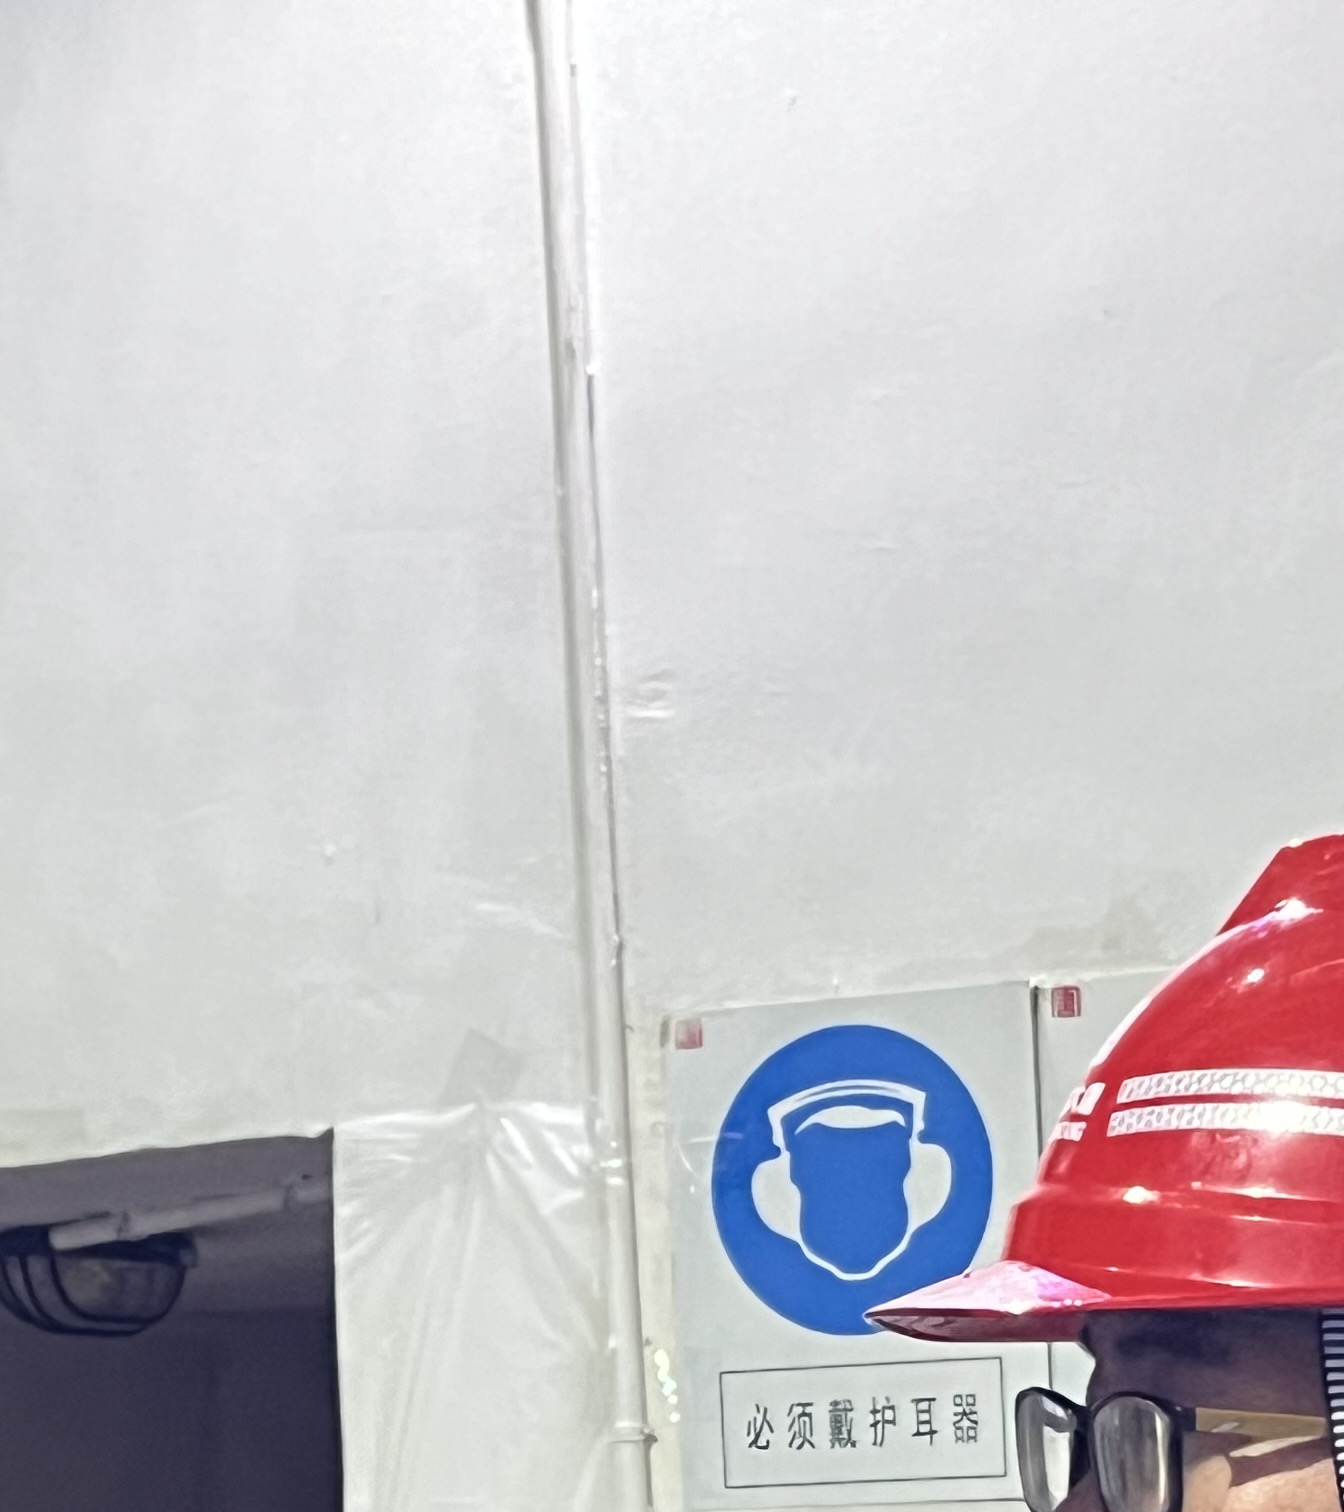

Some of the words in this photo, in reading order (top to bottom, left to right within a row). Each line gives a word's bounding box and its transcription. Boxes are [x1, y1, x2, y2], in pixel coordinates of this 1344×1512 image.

[746, 1393, 979, 1451] 必须戴护耳器
